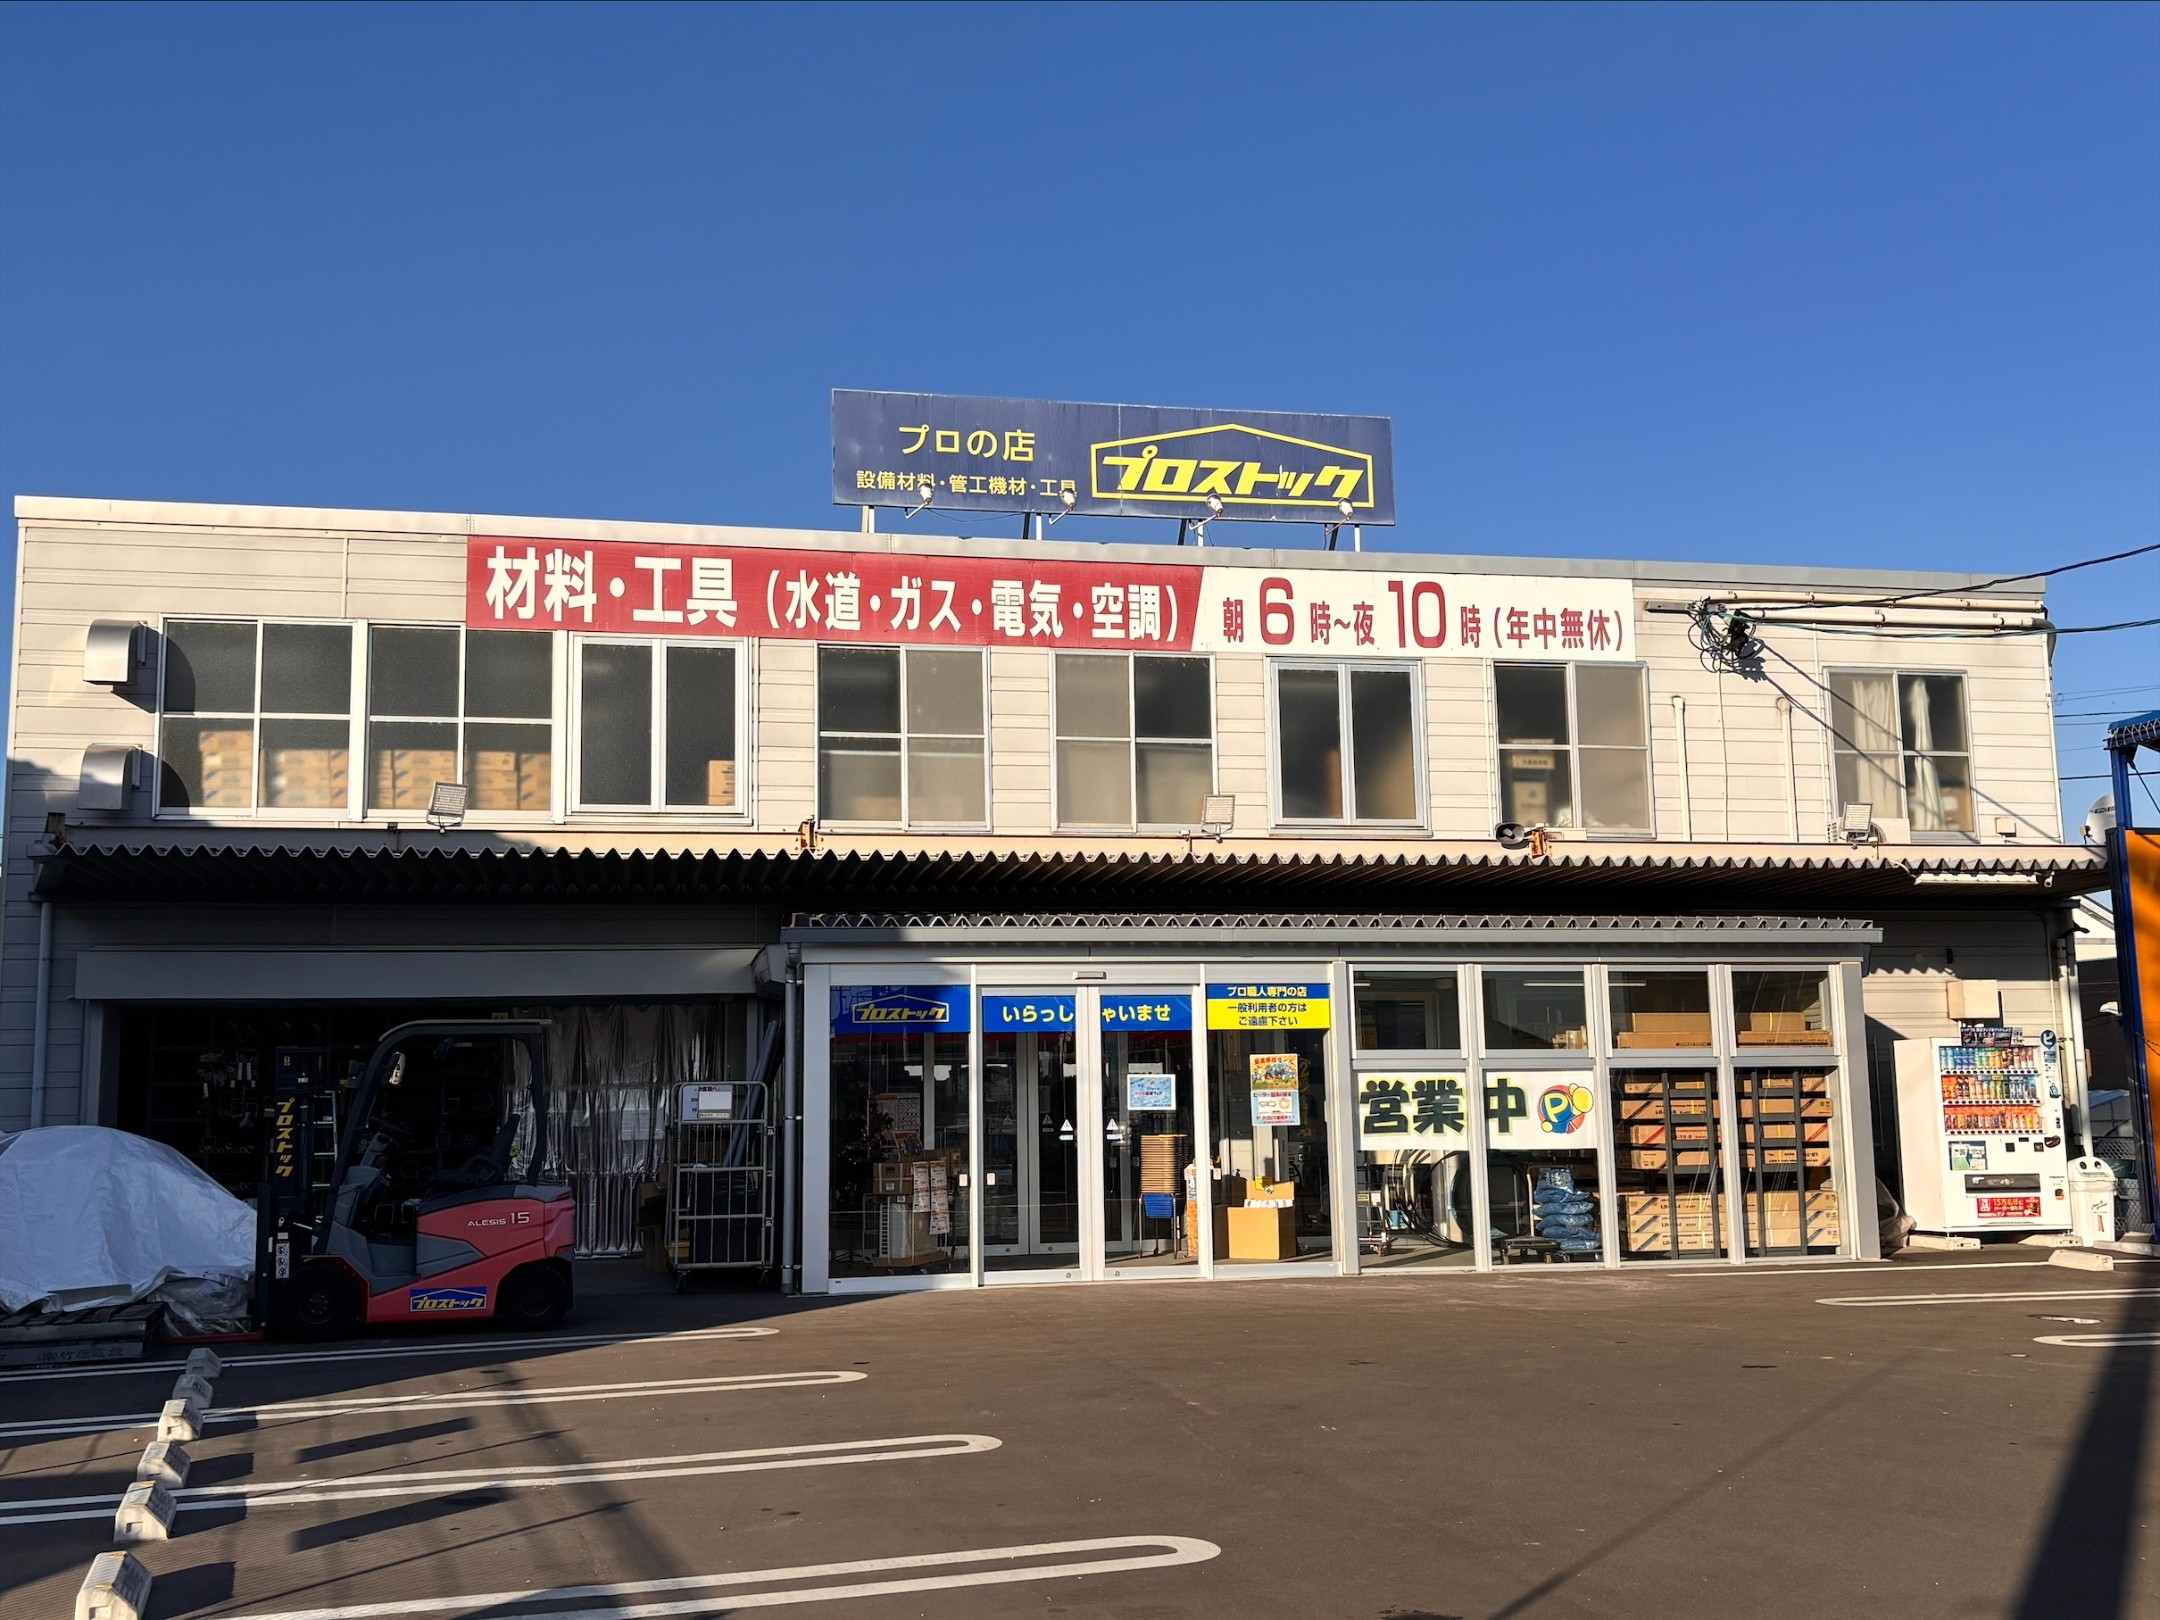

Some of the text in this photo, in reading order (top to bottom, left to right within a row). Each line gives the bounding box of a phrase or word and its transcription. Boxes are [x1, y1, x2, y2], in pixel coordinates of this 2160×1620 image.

[898, 424, 1035, 463] プロの店
[1101, 446, 1365, 498] プロストック
[856, 470, 1077, 497] 設備材料・管工機材・工具
[1227, 986, 1307, 997] プロ職人専門の店
[856, 1003, 946, 1020] プロストック
[1227, 1003, 1307, 1013] 一般利用者の方は
[1239, 1016, 1298, 1026] ご遠慮下さい
[275, 1097, 295, 1177] プロストック
[467, 1211, 530, 1227] ALESIS 15
[413, 1296, 484, 1309] プロストック
